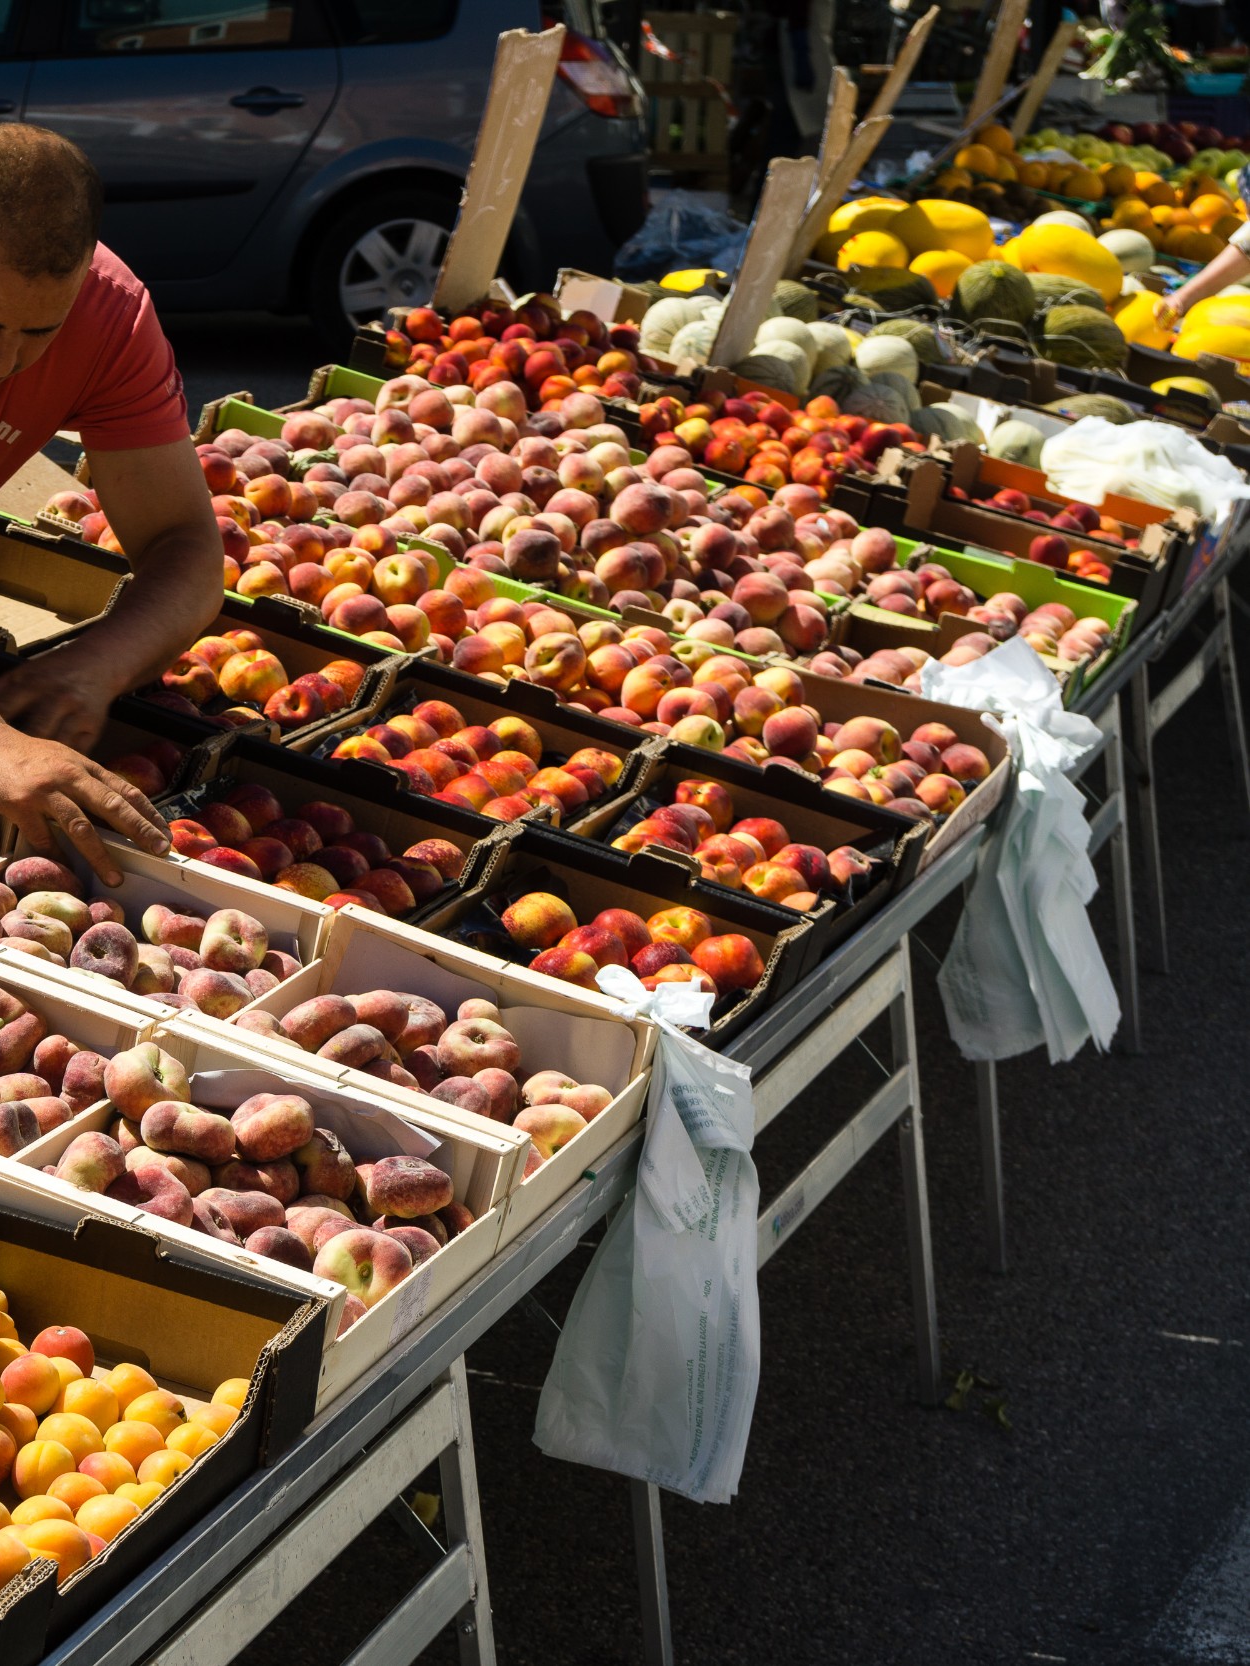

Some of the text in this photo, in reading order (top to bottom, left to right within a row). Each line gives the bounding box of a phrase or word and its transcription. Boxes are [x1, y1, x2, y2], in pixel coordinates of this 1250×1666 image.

[708, 1225, 718, 1242] NON
[715, 1155, 729, 1188] ASPORTO
[698, 1348, 707, 1362] PER
